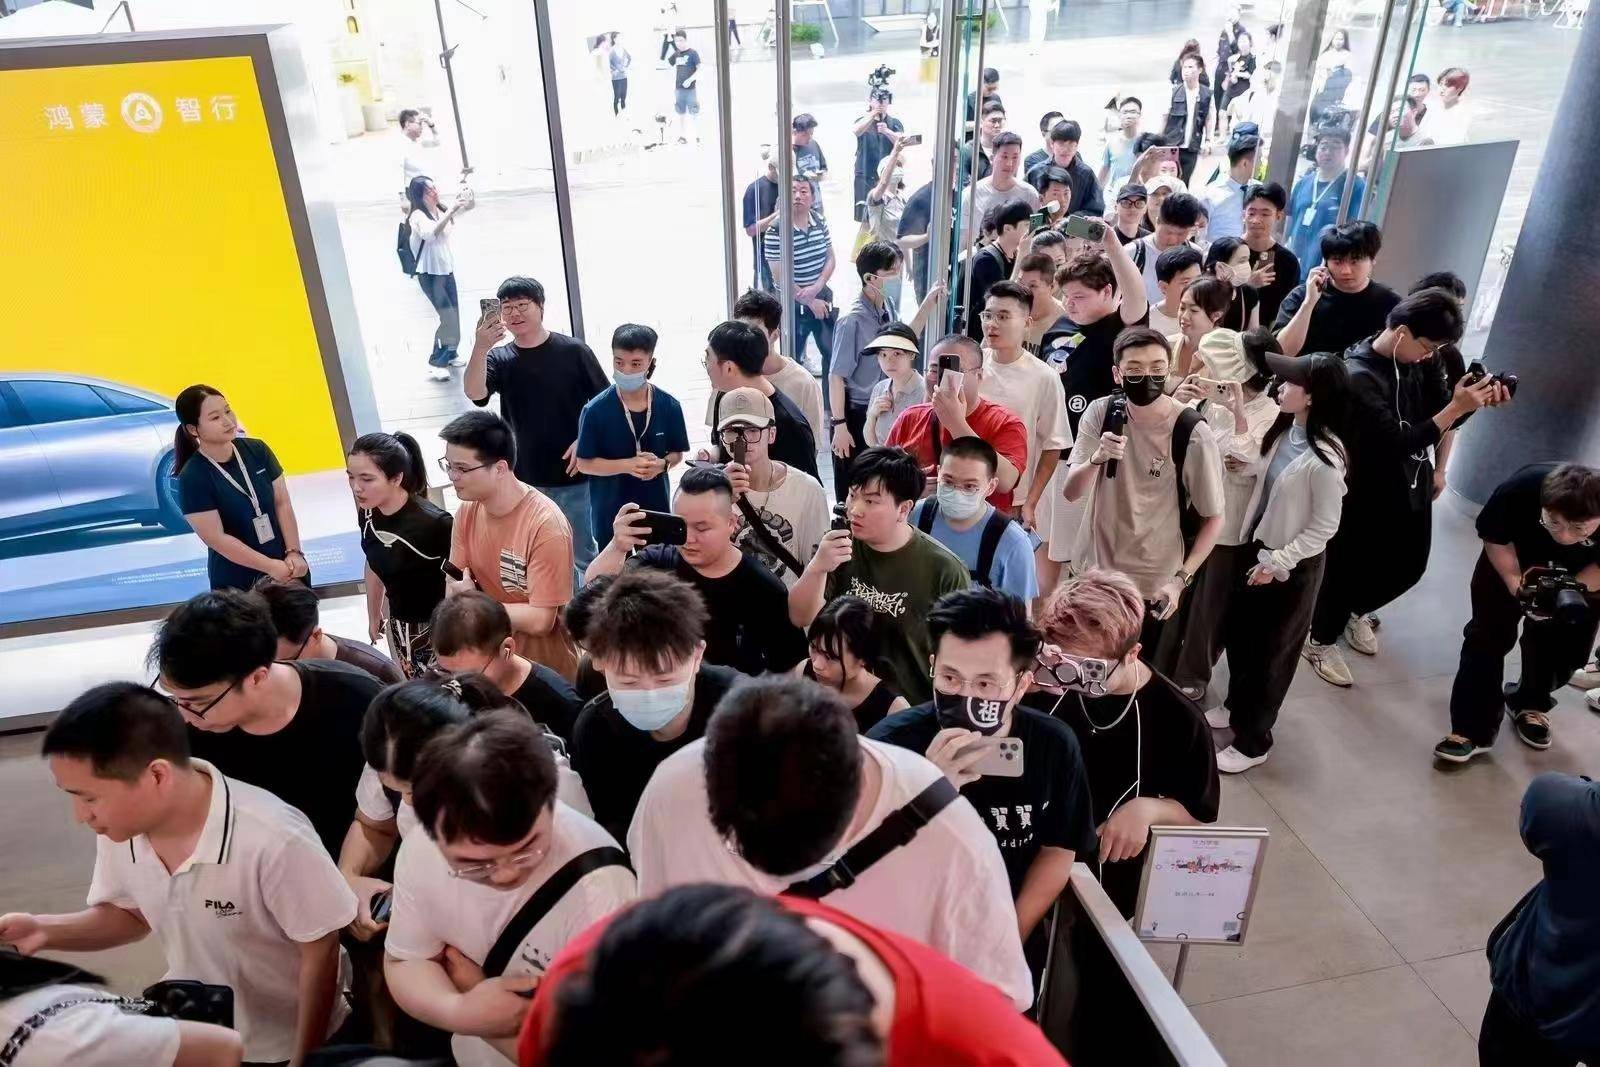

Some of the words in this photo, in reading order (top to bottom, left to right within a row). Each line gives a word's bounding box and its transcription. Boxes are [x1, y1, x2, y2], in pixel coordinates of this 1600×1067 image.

[43, 102, 109, 130] 鸿蒙
[175, 95, 237, 122] 智行
[977, 699, 1001, 722] 祖
[205, 899, 236, 909] FILA
